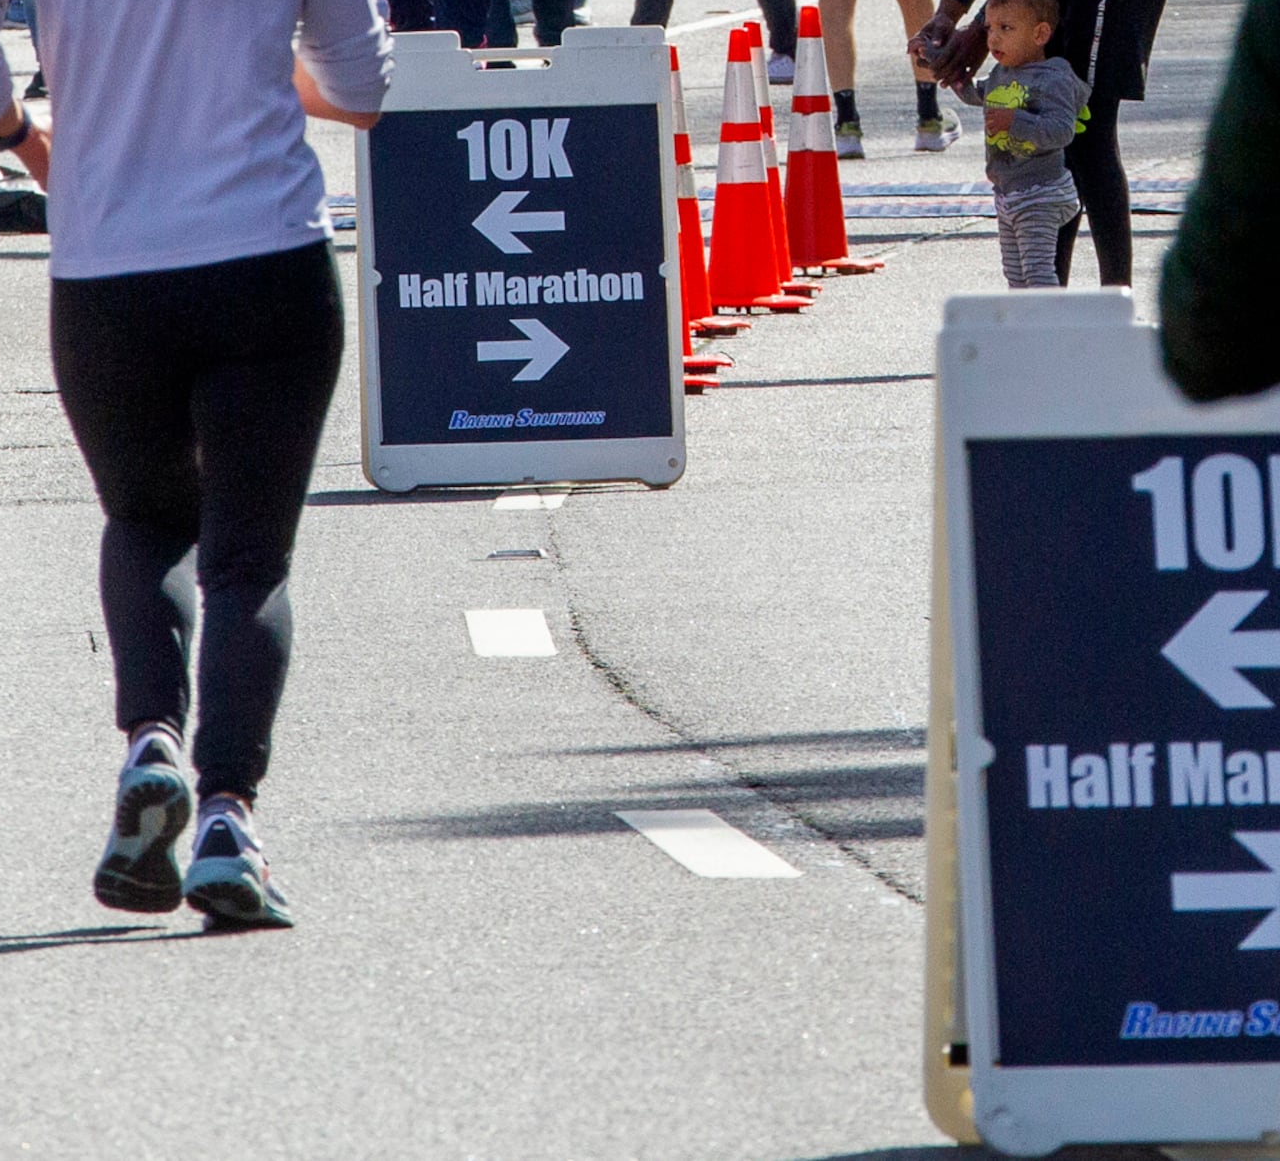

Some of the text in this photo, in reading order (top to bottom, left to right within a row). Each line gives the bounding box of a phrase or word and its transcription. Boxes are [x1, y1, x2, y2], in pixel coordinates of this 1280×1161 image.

[457, 117, 574, 182] 10K
[398, 268, 644, 308] Half Marathon
[1025, 743, 1155, 808] Half
